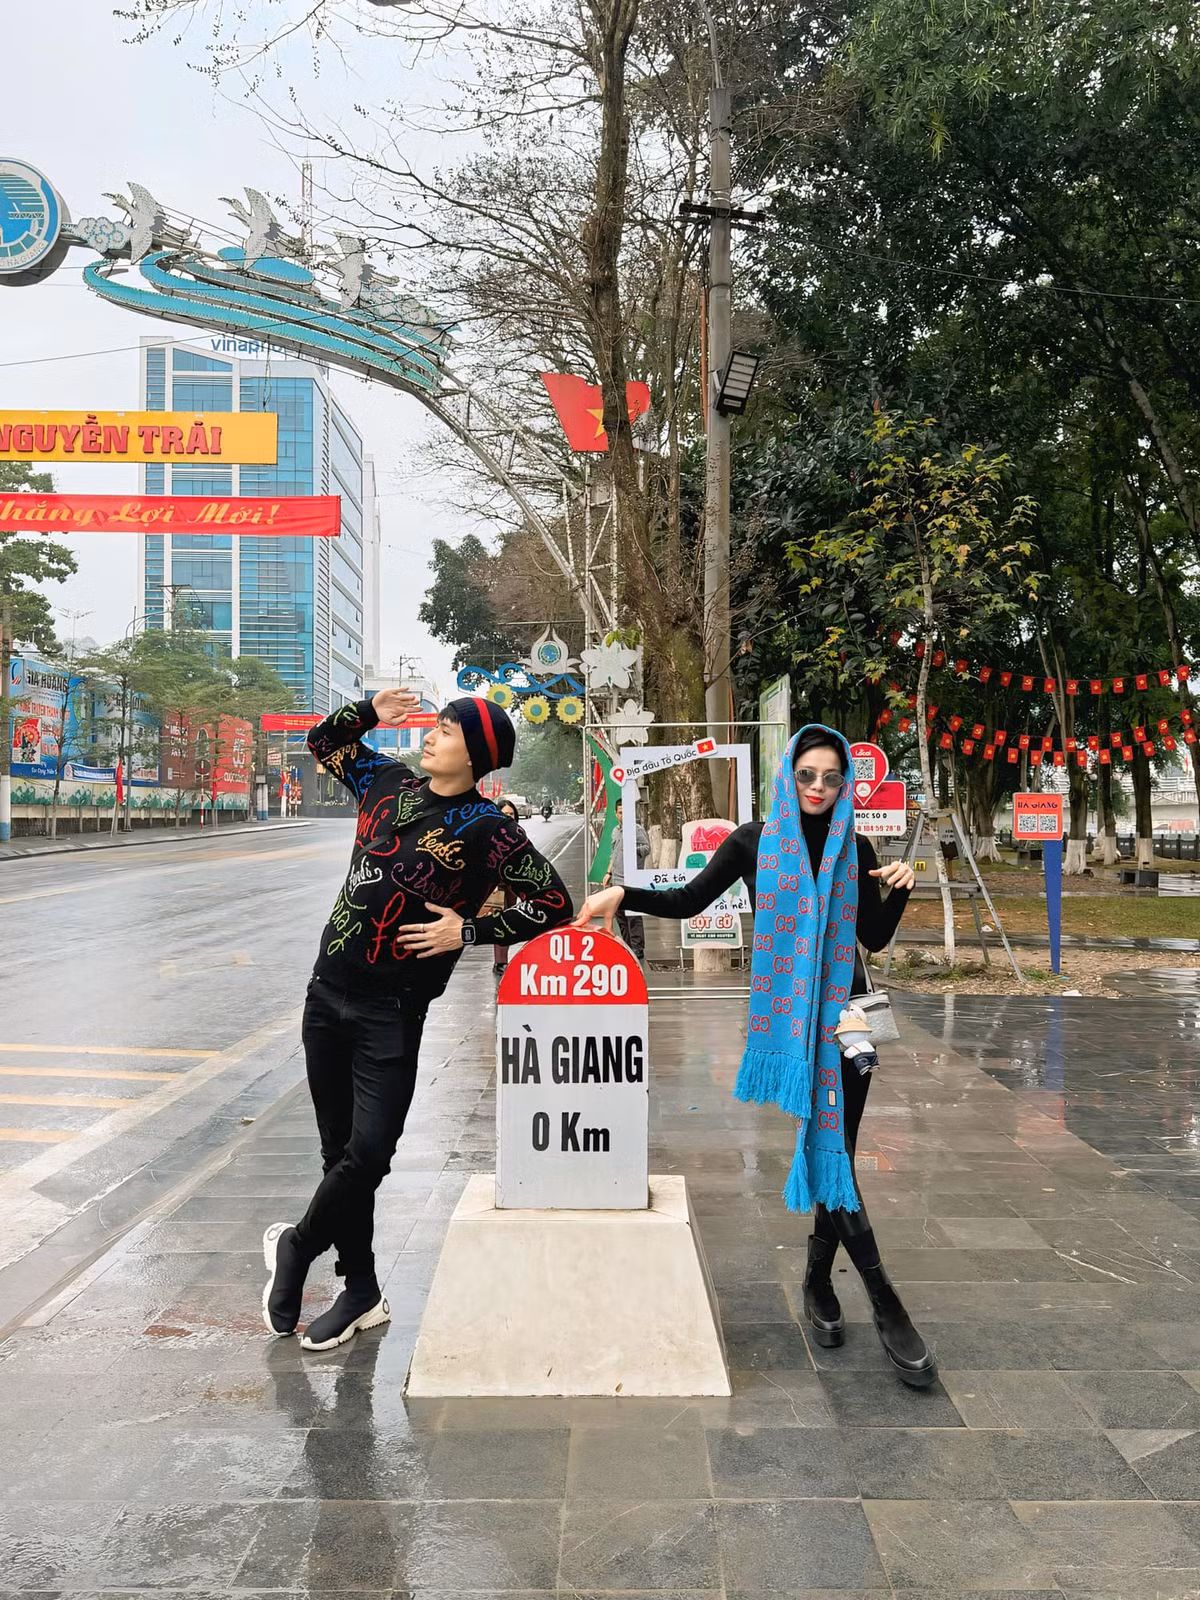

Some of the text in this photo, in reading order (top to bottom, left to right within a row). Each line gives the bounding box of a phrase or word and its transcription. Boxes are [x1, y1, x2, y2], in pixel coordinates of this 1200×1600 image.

[138, 420, 222, 455] TRÃI
[0, 499, 281, 528] hắng Lợi Mới!
[653, 874, 669, 884] Đã
[732, 897, 748, 909] nè!
[688, 915, 713, 932] CỘT
[550, 934, 594, 963] QL 2
[520, 963, 628, 997] Km 290
[501, 1023, 644, 1084] HÀ GIANG
[532, 1111, 610, 1152] 0 Km
